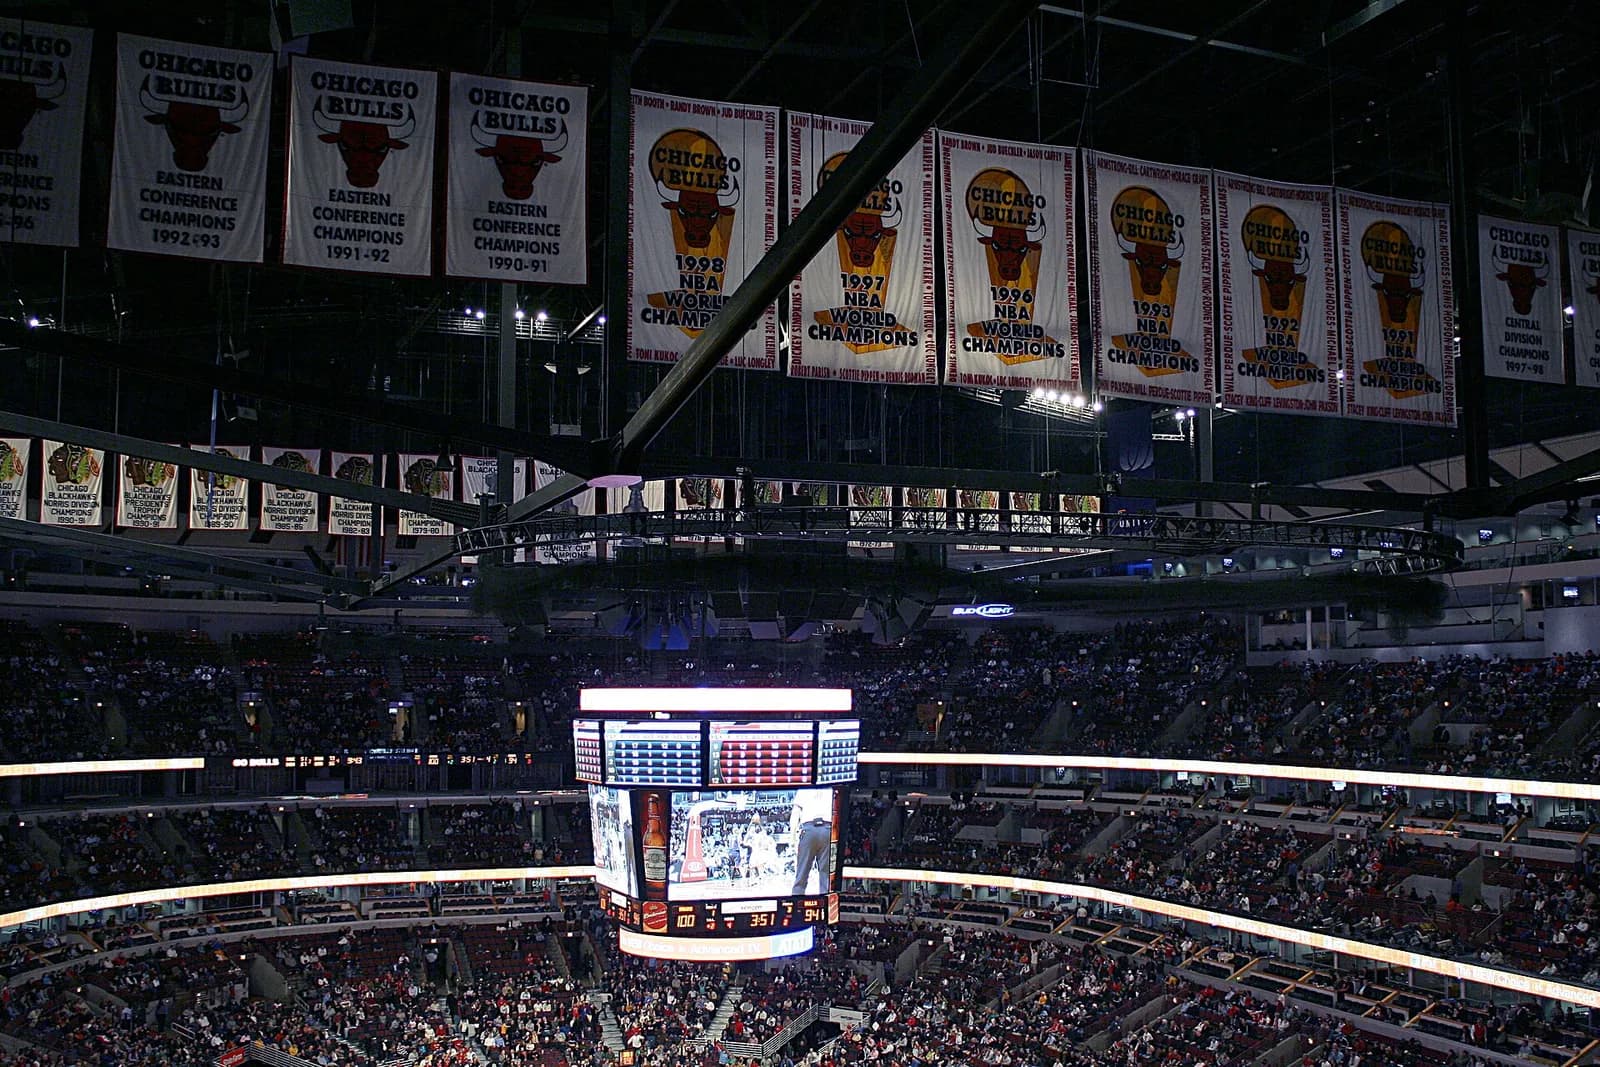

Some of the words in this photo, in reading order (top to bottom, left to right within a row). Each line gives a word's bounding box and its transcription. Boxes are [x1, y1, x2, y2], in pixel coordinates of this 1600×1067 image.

[139, 50, 252, 82] CHICAGO
[157, 75, 236, 102] BULLS
[311, 72, 418, 99] CHICAGO
[328, 96, 403, 119] BULLS
[469, 88, 570, 114] CHICAGO
[670, 100, 691, 112] RANDY
[693, 103, 716, 116] BROWN
[722, 108, 732, 118] JUD
[485, 111, 556, 134] BULLS
[765, 112, 776, 129] SCOTT
[656, 148, 740, 172] CHICAGO
[156, 171, 222, 190] EASTERN
[669, 169, 730, 190] BULLS
[792, 170, 802, 196] BRIAN
[140, 188, 237, 211] CONFERENCE
[329, 189, 390, 206] EASTERN
[765, 181, 775, 207] HARPER
[972, 187, 1046, 209] CHICAGO
[313, 206, 405, 227] CONFERENCE
[488, 201, 547, 218] EASTERN
[983, 206, 1036, 226] BULLS
[1116, 204, 1184, 228] CHICAGO
[140, 208, 235, 230] CHAMPIONS
[473, 218, 561, 237] CONFERENCE
[314, 226, 403, 245] CHAMPIONS
[1127, 223, 1176, 244] BULLS
[1246, 221, 1309, 244] CHICAGO
[1490, 227, 1550, 248] CHICAGO
[327, 245, 390, 262] 1991-92
[474, 237, 560, 255] CHAMPIONS
[1257, 240, 1302, 259] BULLS
[1366, 238, 1425, 258] CHICAGO
[1500, 245, 1544, 264] BULLS
[488, 257, 547, 273] 1990-91
[676, 254, 724, 272] 1998
[1376, 255, 1418, 274] BULLS
[680, 274, 720, 291] NBA
[840, 274, 884, 290] 1997
[844, 292, 882, 308] NBA
[991, 286, 1032, 303] 1996
[641, 308, 719, 328] CHAMP
[792, 292, 802, 332] SIMPKINS
[830, 308, 896, 326] WORLD
[995, 304, 1030, 320] NBA
[1133, 301, 1170, 318] 1993
[982, 320, 1044, 338] WORLD
[1137, 319, 1168, 334] NBA
[1263, 316, 1298, 330] 1992
[1505, 317, 1540, 330] CENTRAL
[808, 324, 918, 346] CHAMPIONS
[1125, 334, 1180, 352] WORLD
[1266, 332, 1296, 348] NBA
[1382, 328, 1414, 344] 1991
[1504, 332, 1542, 346] DIVISION
[636, 348, 652, 360] TONI
[734, 356, 746, 366] LUC
[792, 336, 802, 365] DICKEY
[962, 338, 1065, 358] CHAMPIONS
[1255, 347, 1307, 364] WORLD
[1386, 344, 1412, 358] NBA
[1499, 346, 1550, 361] CHAMPIONS
[1108, 348, 1199, 372] CHAMPIONS
[1376, 360, 1424, 374] WORLD
[1238, 362, 1325, 382] CHAMPIONS
[1360, 374, 1442, 394] CHAMPIONS
[48, 492, 96, 500] BLACKHAWKS
[124, 492, 172, 500] BLACKHAWKS
[51, 508, 92, 516] CHAMPIONS
[335, 503, 373, 511] BLACKHAW
[127, 512, 166, 521] CHAMPIONS
[677, 914, 695, 928] 100
